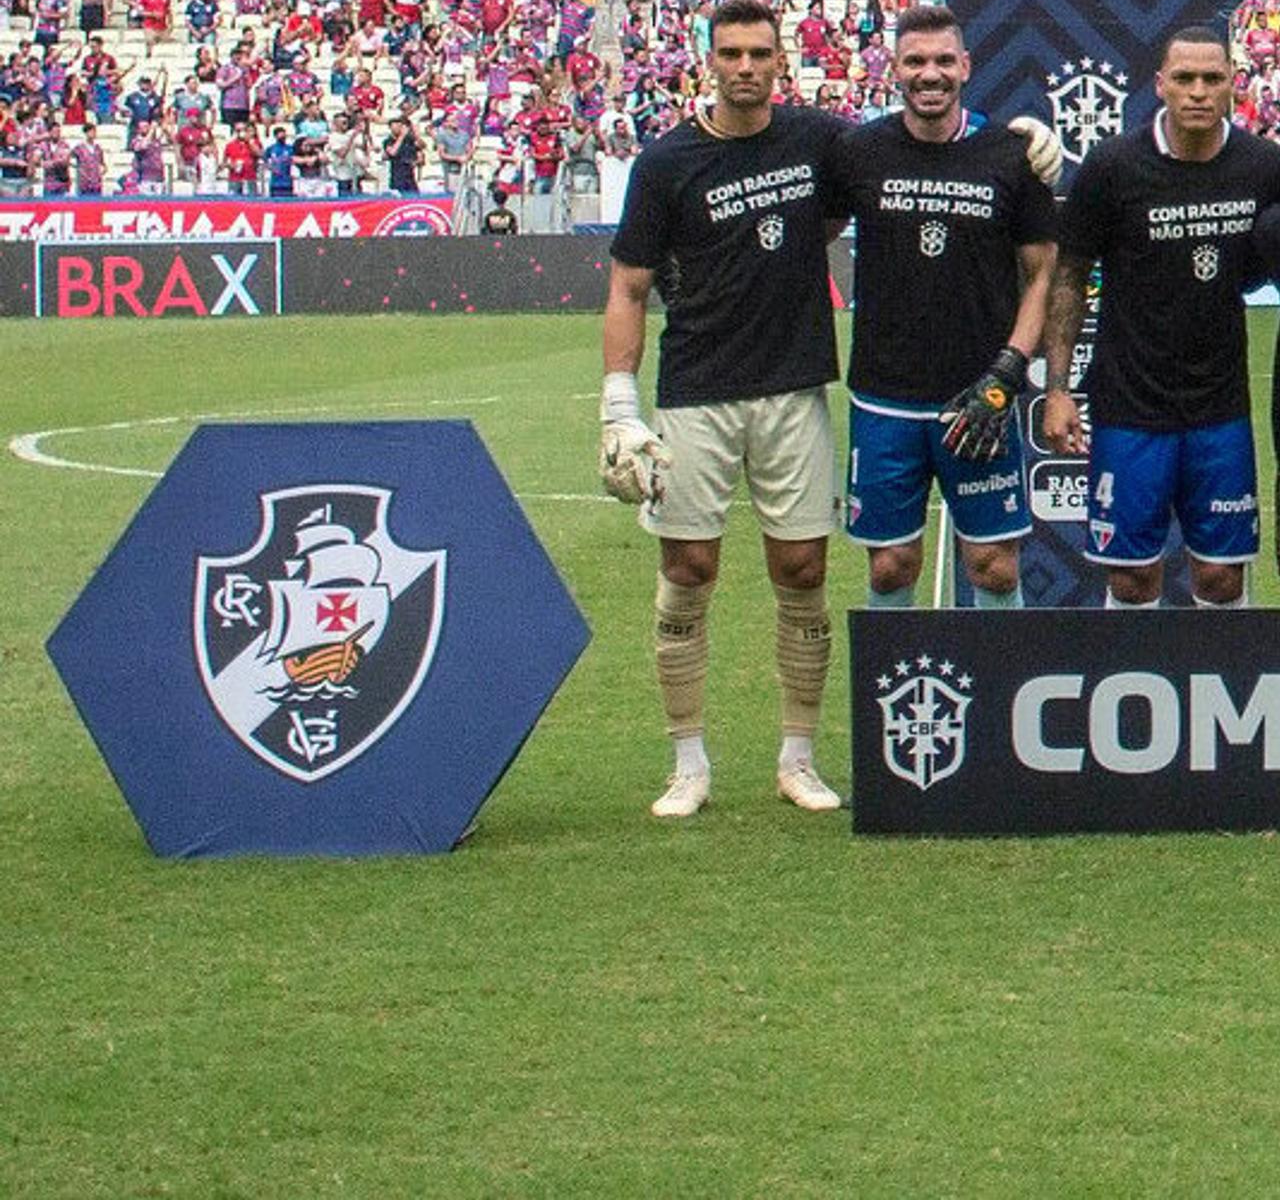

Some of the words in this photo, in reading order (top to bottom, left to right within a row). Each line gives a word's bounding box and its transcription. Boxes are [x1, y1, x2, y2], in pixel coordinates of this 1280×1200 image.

[706, 181, 742, 204] COM
[743, 165, 812, 192] RACISMO
[883, 180, 919, 193] COM
[922, 180, 994, 201] RACISMO
[745, 191, 779, 209] TEM
[917, 199, 950, 212] TEM
[1149, 206, 1185, 222] COM
[1188, 200, 1256, 219] RACISMO
[1186, 222, 1218, 236] TEM
[57, 253, 261, 316] BRAX
[1095, 471, 1115, 510] 4
[907, 722, 941, 736] CBF
